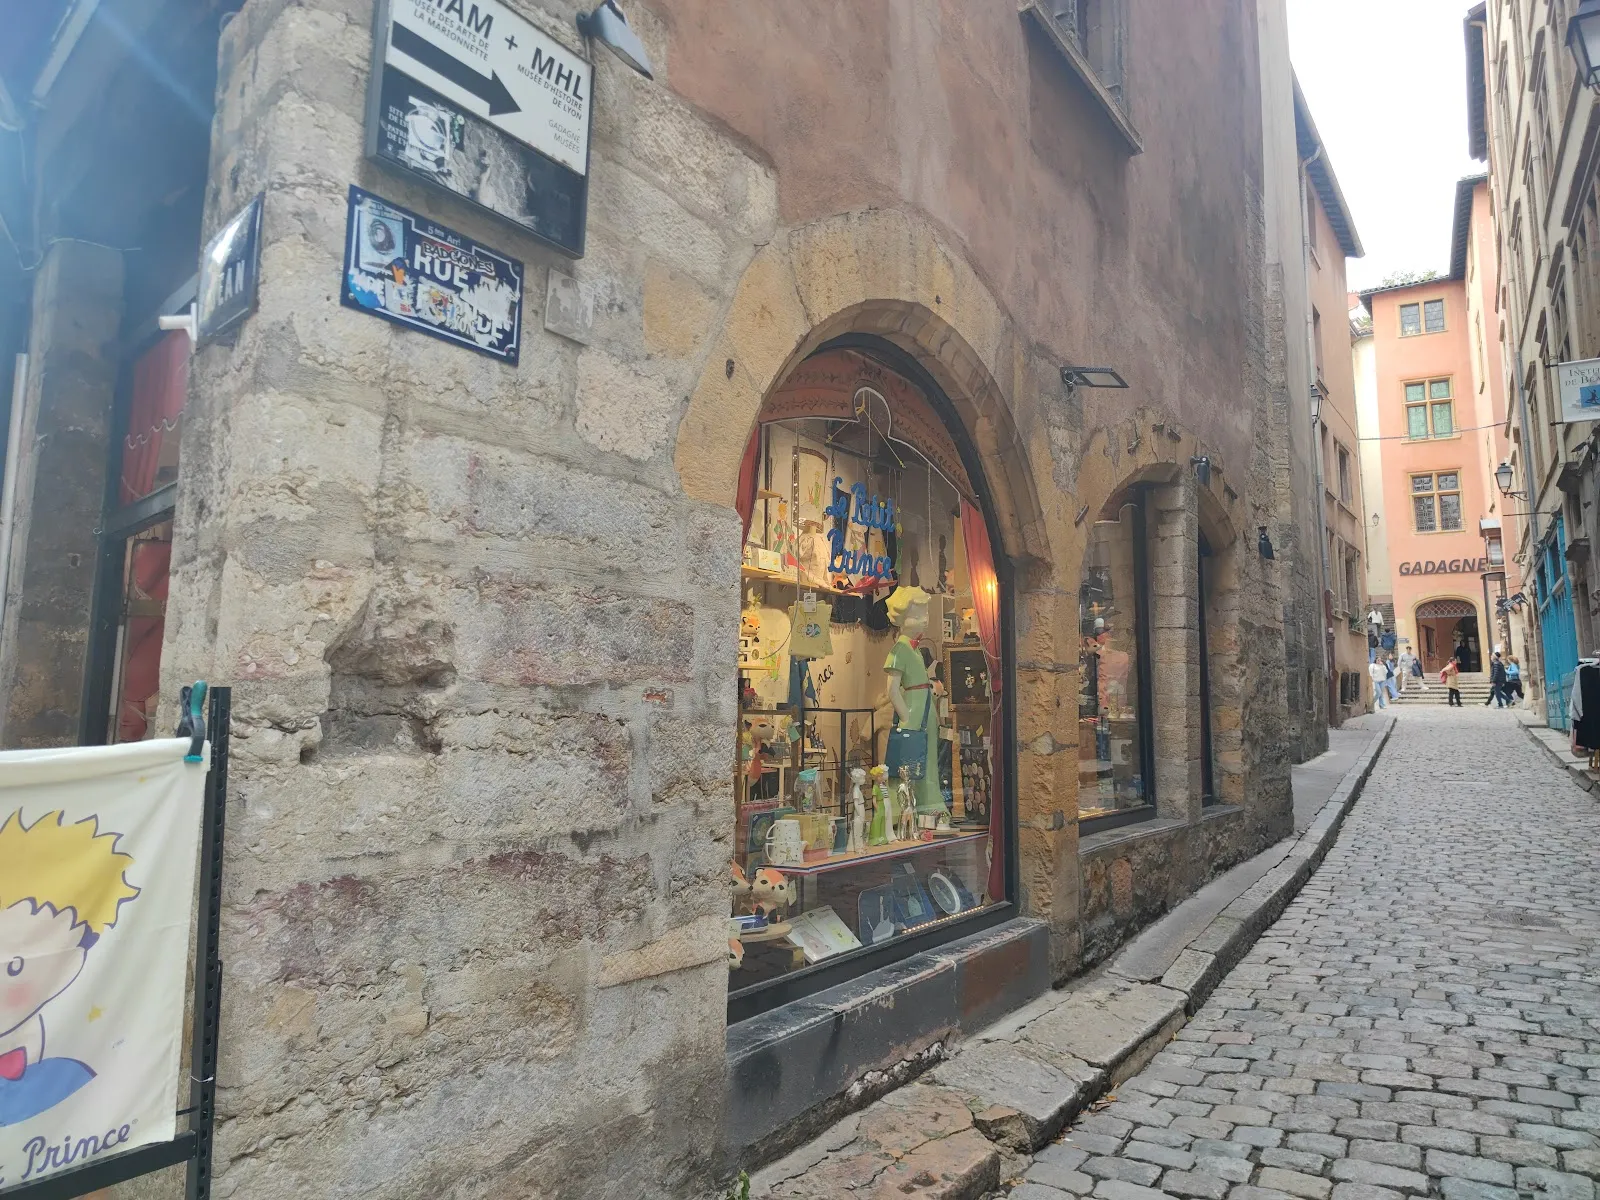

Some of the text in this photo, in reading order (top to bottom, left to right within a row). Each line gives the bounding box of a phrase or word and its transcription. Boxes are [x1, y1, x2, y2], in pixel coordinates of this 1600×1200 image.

[409, 0, 490, 52] USÉE DES ARTS DE
[413, 8, 489, 61] LA MARIONNETTE
[427, 0, 494, 39] AM
[531, 46, 583, 102] MHL
[517, 63, 583, 111] MUSÉE D'HISTOIRE
[552, 97, 582, 120] DE LYON
[548, 119, 580, 143] GADAGNE
[413, 244, 470, 289] RUE
[850, 481, 895, 533] Petit
[826, 528, 893, 579] Prince
[1399, 557, 1487, 577] GADAGNE
[21, 1123, 131, 1180] Prince
